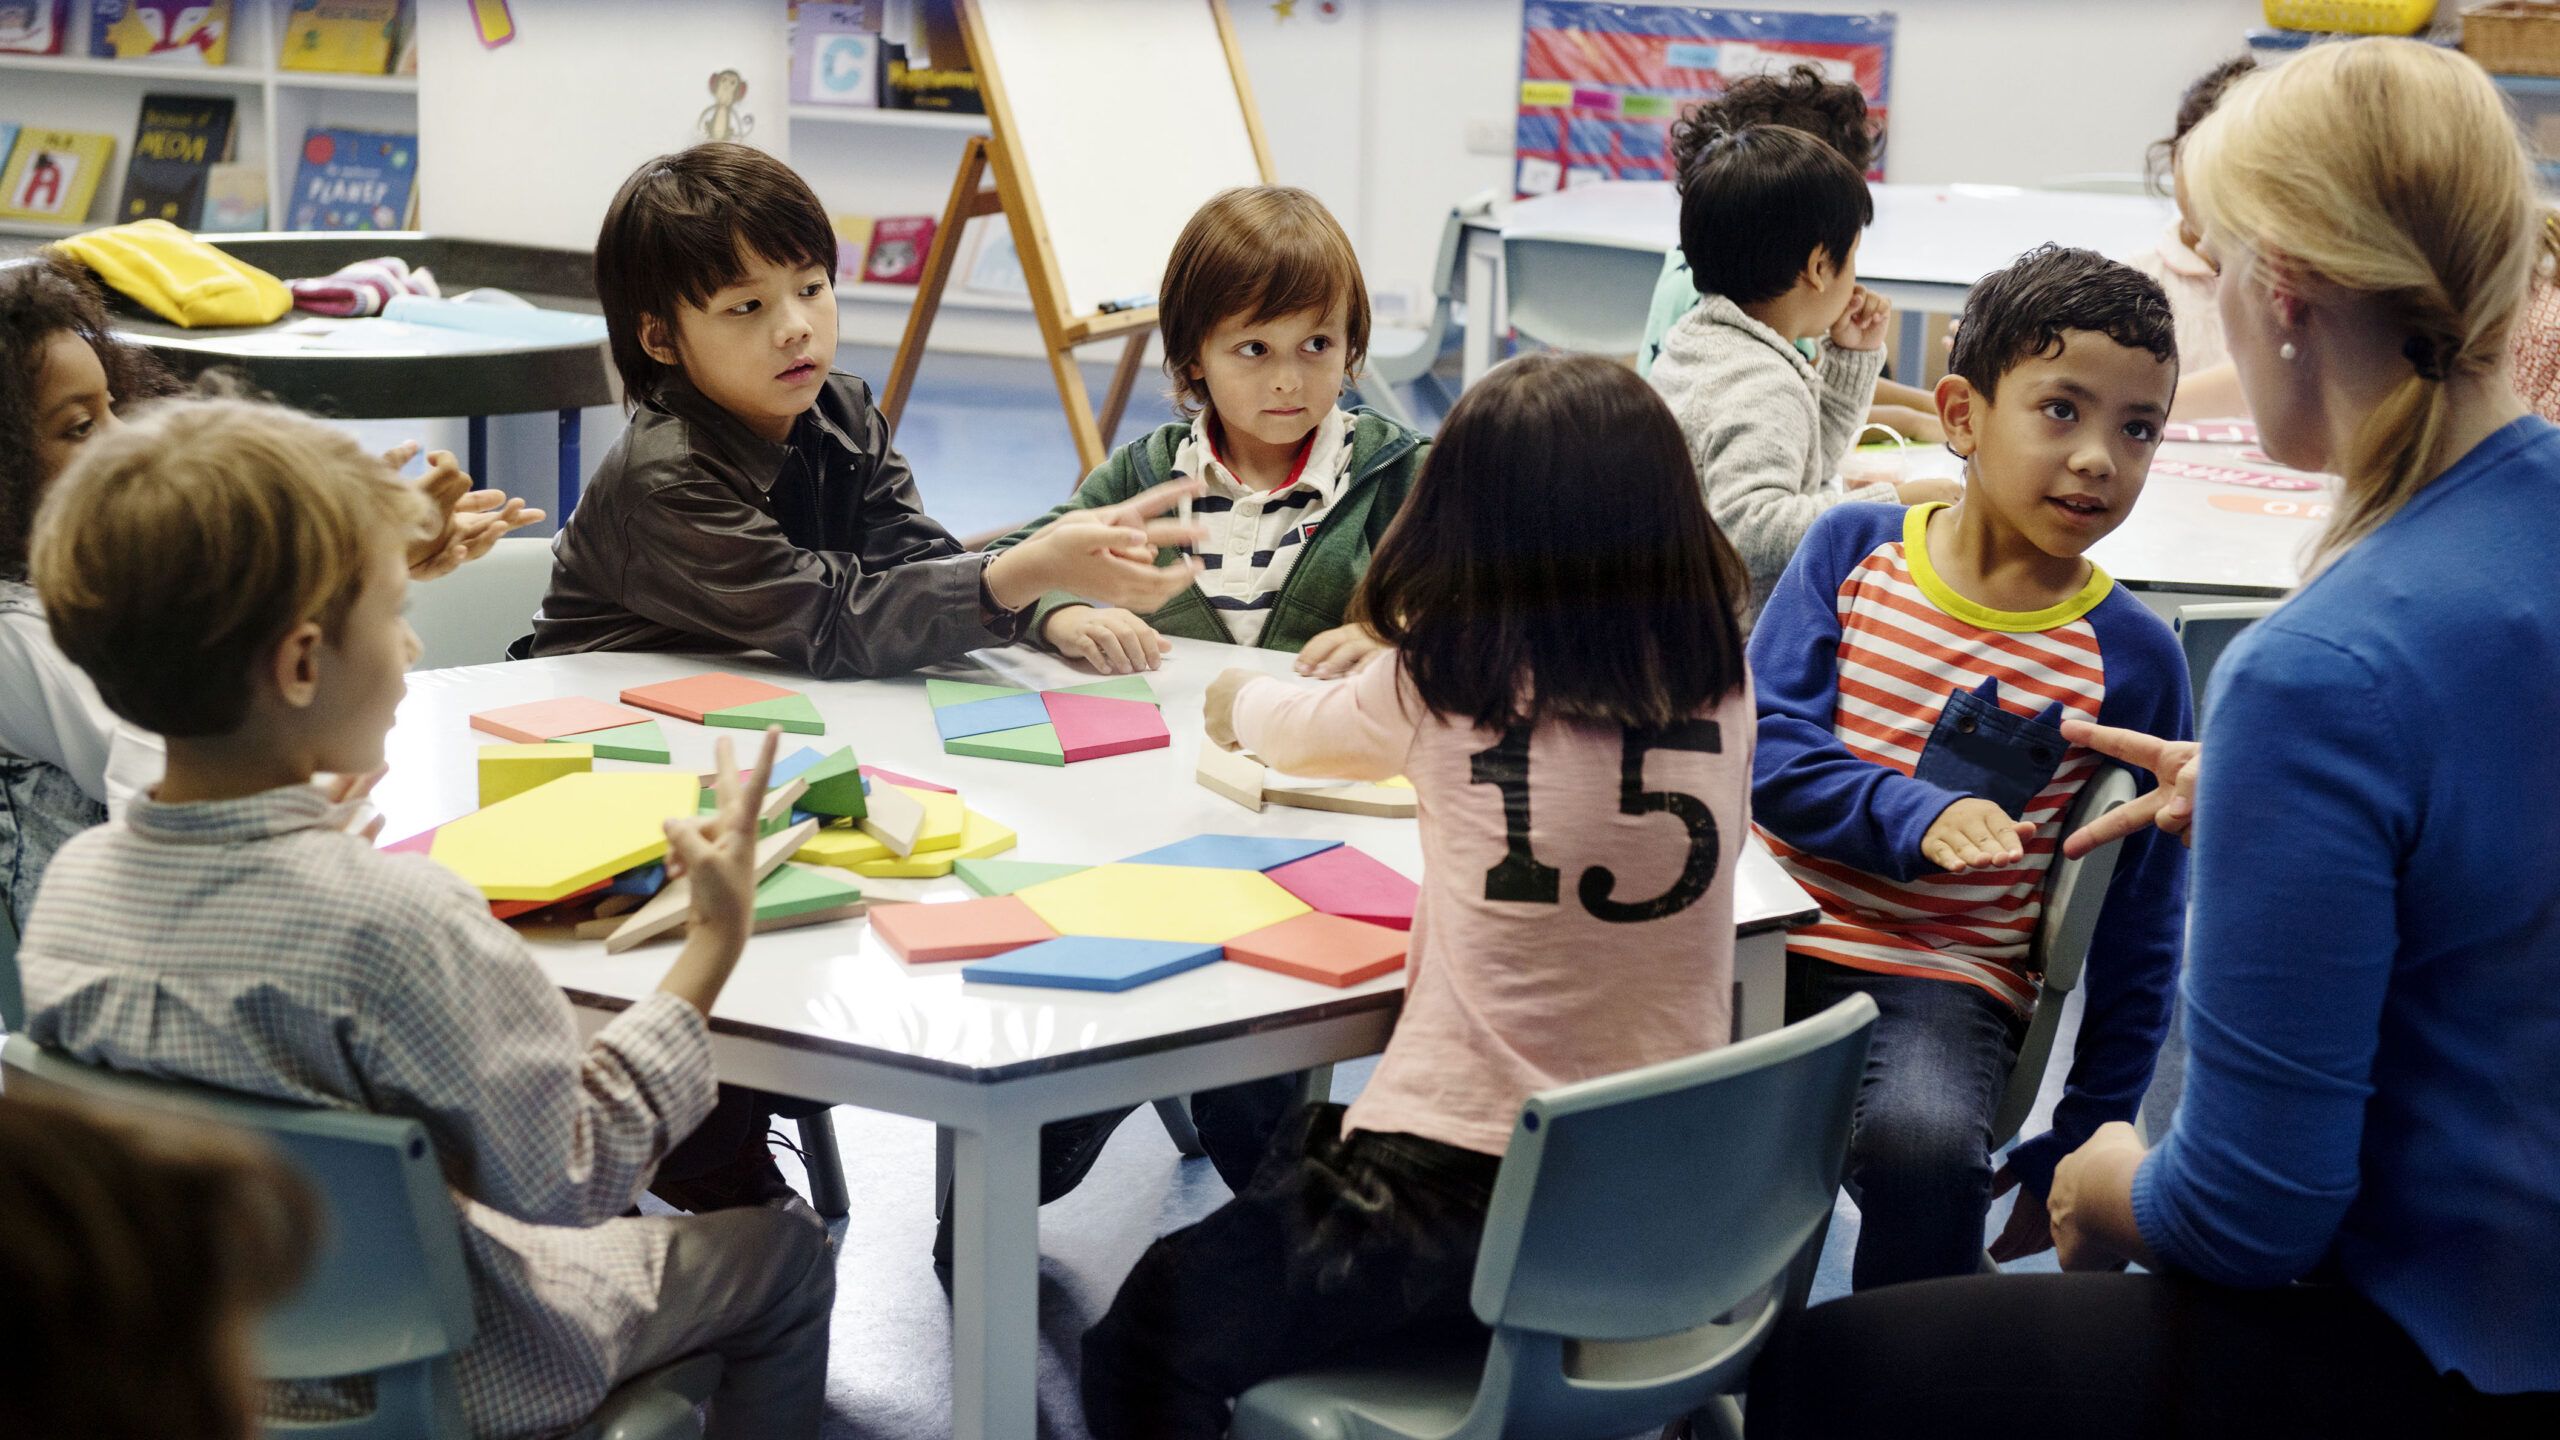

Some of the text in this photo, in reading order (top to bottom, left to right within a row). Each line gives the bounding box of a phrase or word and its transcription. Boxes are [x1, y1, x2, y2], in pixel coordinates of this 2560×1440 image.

[822, 36, 864, 92] C
[23, 160, 62, 209] A
[1469, 716, 1722, 924] 15
